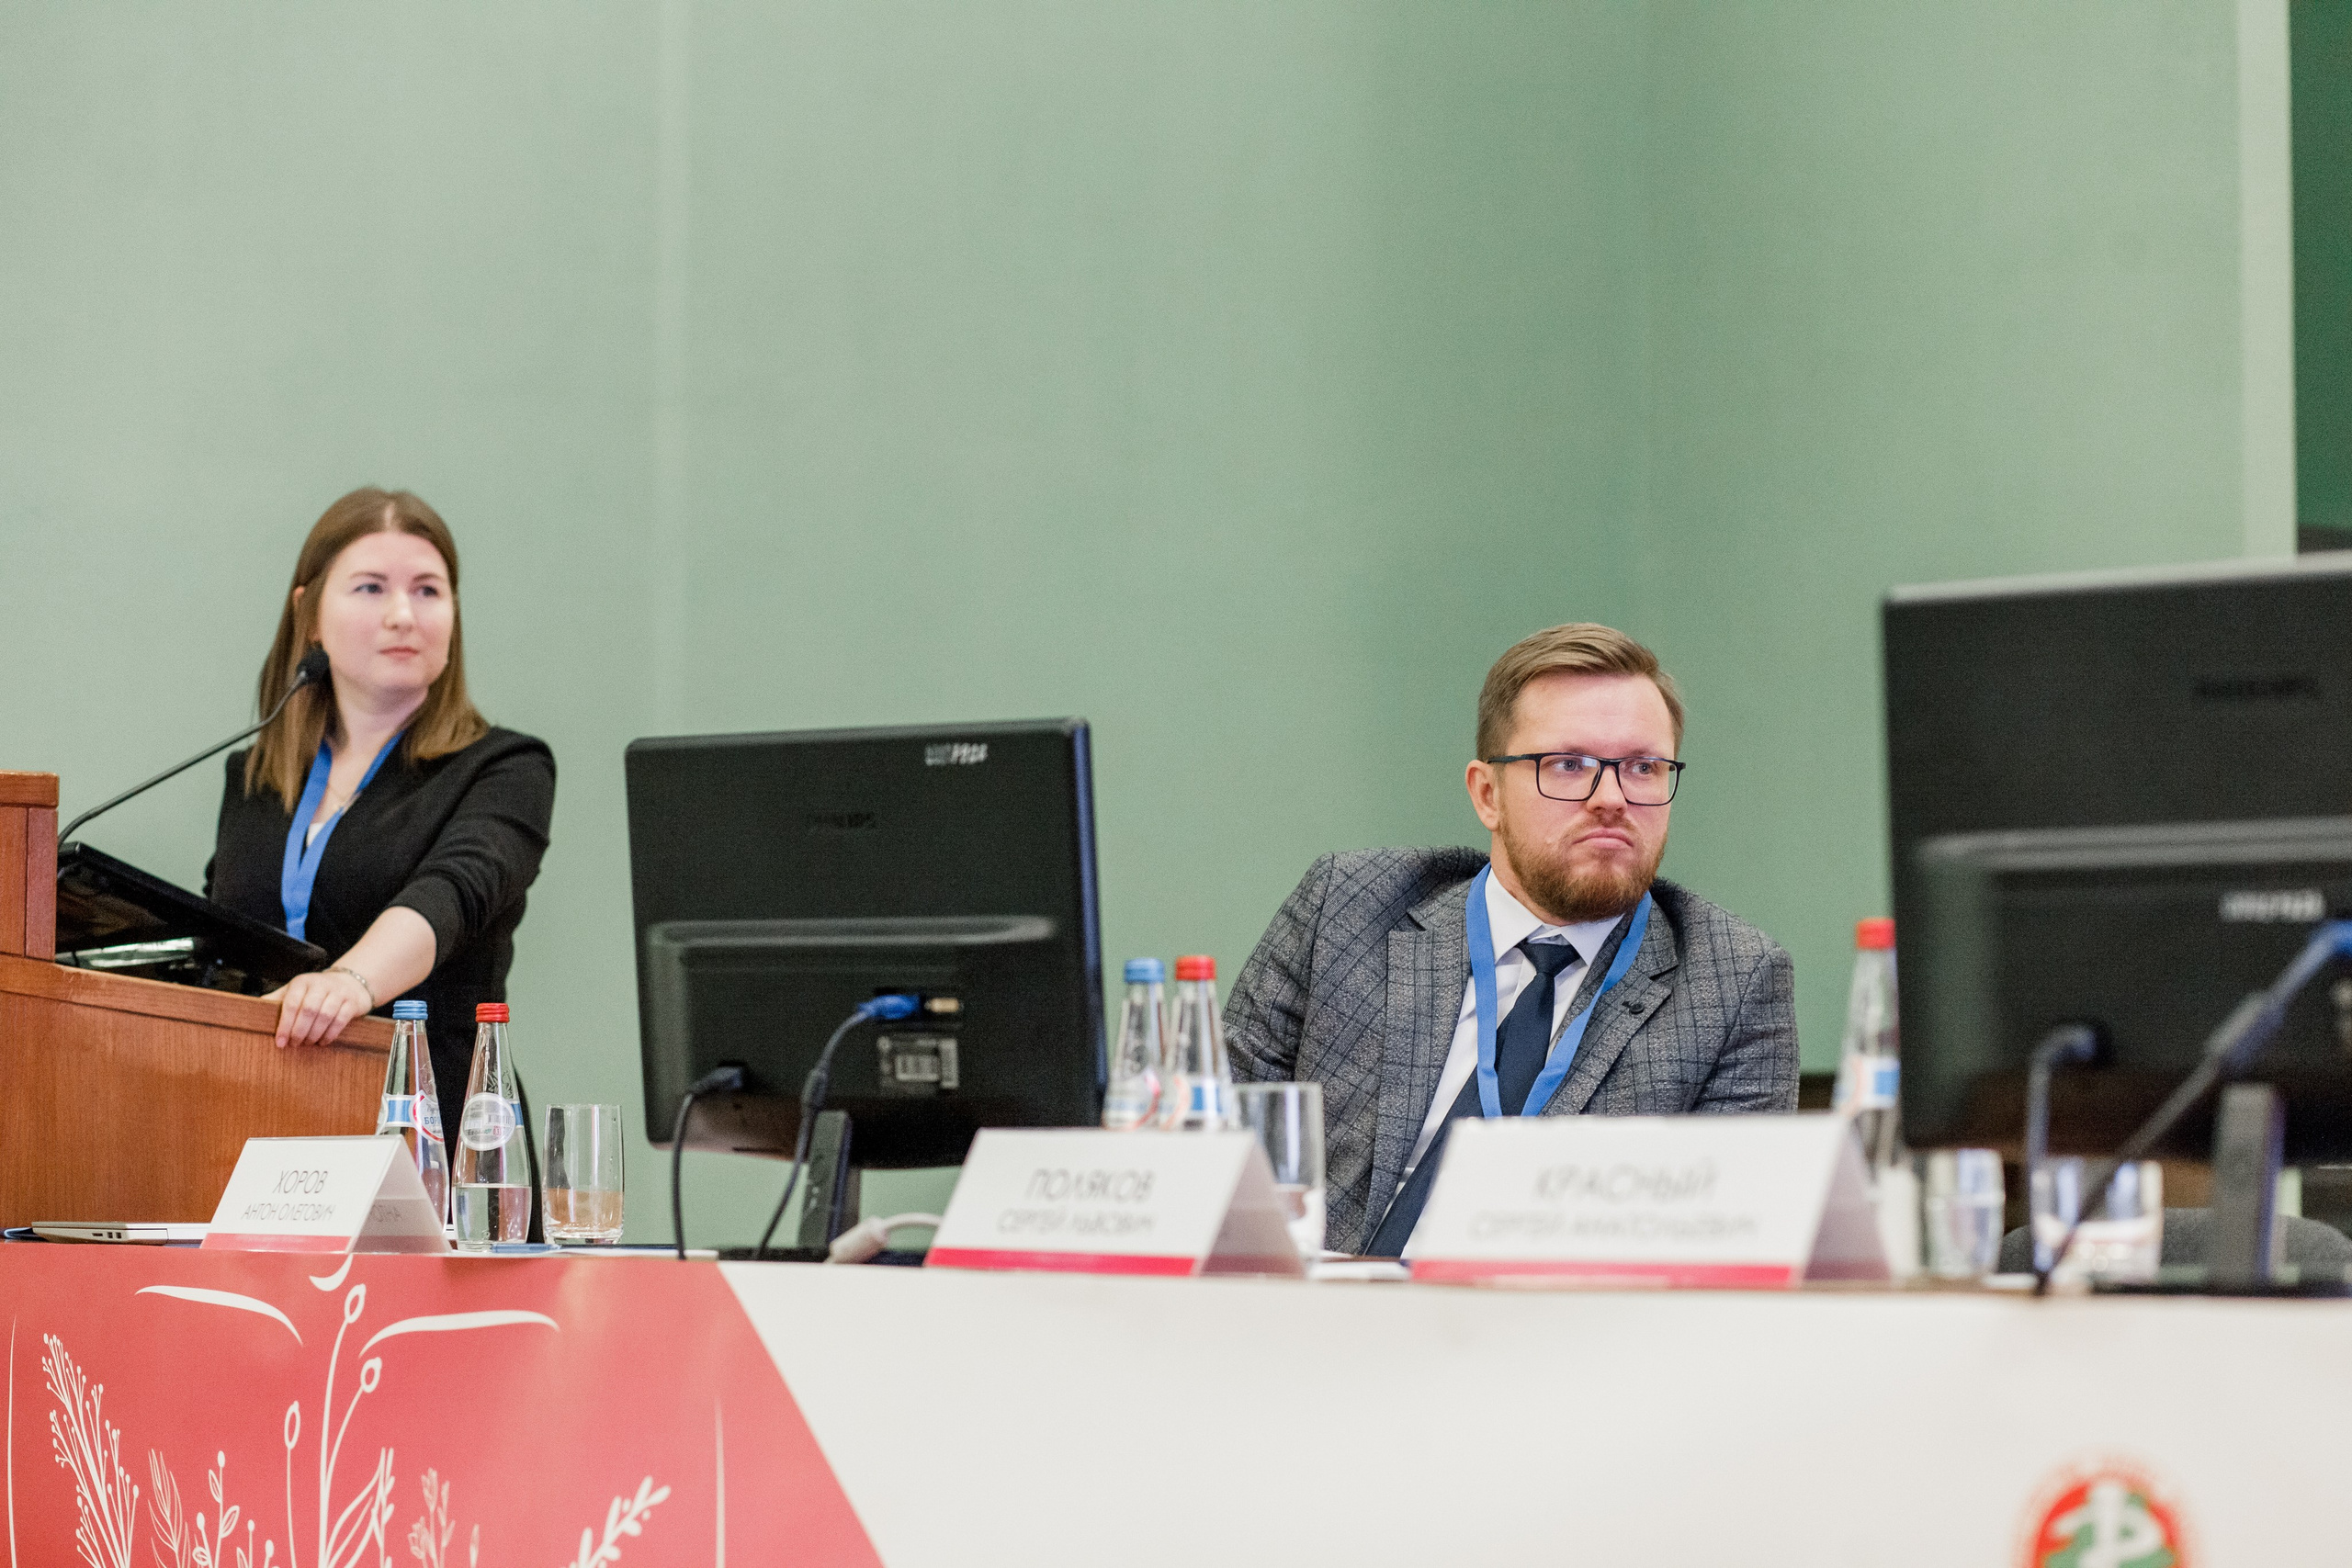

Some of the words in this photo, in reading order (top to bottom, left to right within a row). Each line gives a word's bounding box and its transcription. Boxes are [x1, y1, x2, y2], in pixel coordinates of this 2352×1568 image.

[272, 1170, 328, 1193] ХОРОВ
[1025, 1168, 1156, 1202] ПОЛЯКОВ
[1532, 1156, 1720, 1204] КРАСНЫЙ
[241, 1203, 277, 1220] АНТОН
[277, 1203, 336, 1221] ОЛЕГОВИЧ
[997, 1205, 1069, 1234] СЕРГЕЙ
[1072, 1211, 1157, 1235] ЛЬВОВИЧ
